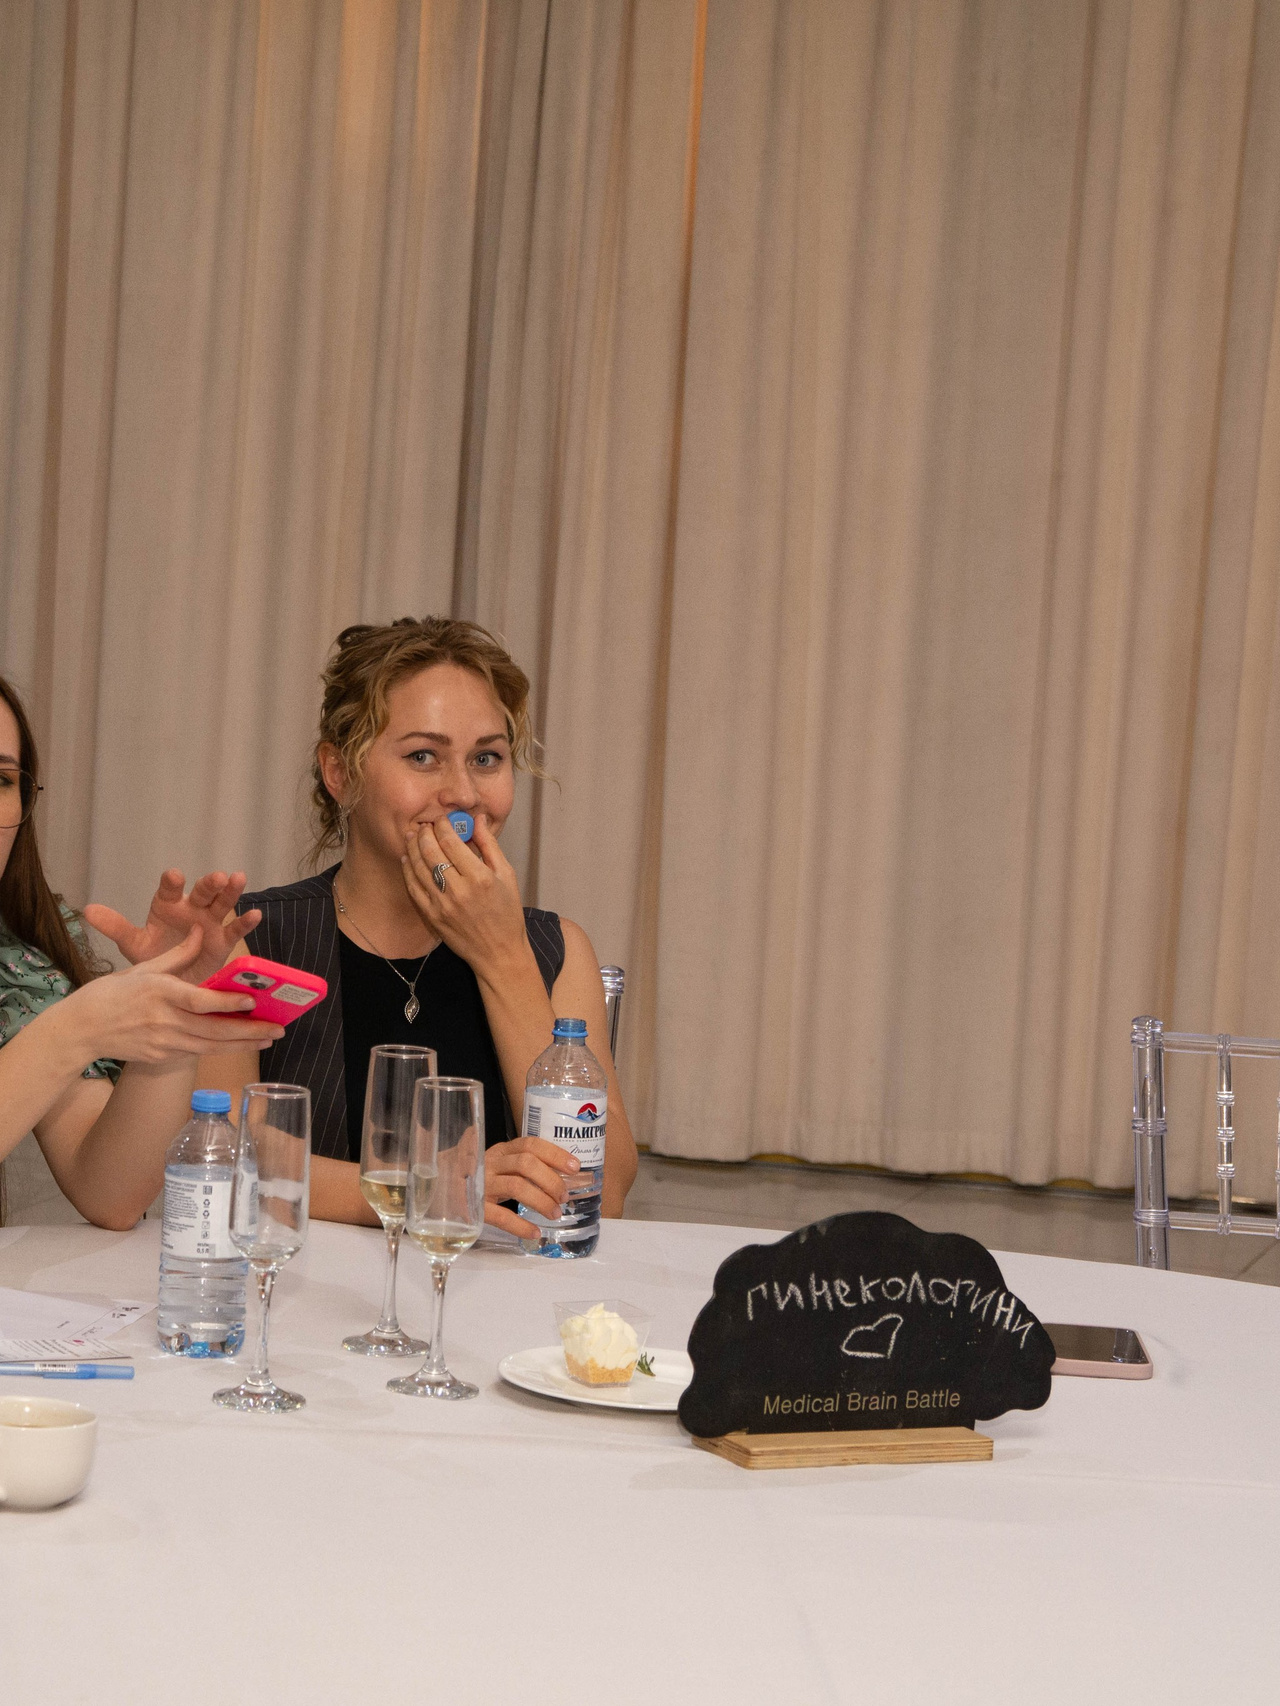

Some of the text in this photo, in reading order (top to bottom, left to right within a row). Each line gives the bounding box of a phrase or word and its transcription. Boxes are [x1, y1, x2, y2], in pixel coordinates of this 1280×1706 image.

[763, 1389, 961, 1415] Medical Brain Battle
